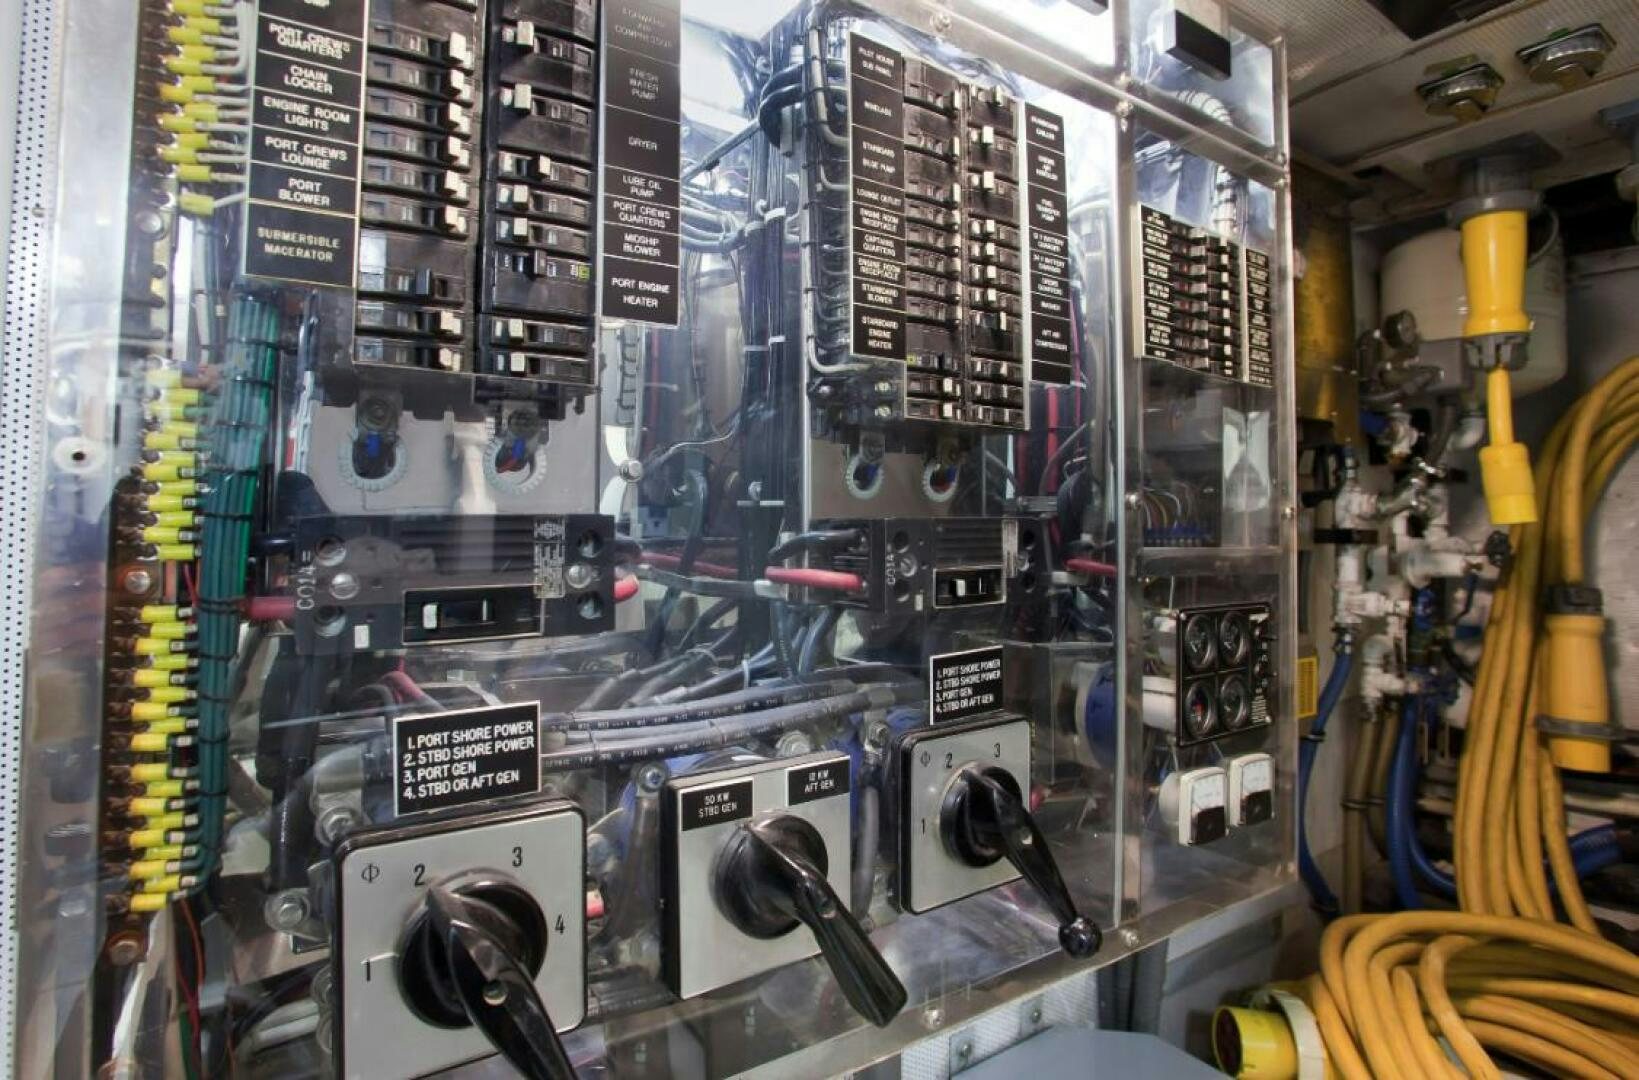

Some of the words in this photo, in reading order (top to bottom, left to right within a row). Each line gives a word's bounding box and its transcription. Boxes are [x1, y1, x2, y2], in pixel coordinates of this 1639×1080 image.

[269, 22, 303, 40] PORT
[277, 37, 342, 60] QUARTERS
[290, 64, 328, 82] CHAIN
[629, 67, 659, 82] FRESH
[284, 74, 332, 94] LOCKER
[629, 78, 659, 94] WATER
[631, 88, 656, 101] PUMP
[263, 96, 310, 115] ENGINE
[314, 107, 350, 123] ROOM
[285, 113, 329, 131] LIGHTS
[265, 136, 299, 151] PORT
[304, 143, 348, 161] CREWS
[628, 136, 657, 151] DRYER
[281, 152, 331, 170] LOUNGE
[288, 178, 322, 192] PORT
[623, 175, 646, 187] LUBE
[648, 180, 662, 191] OIL
[278, 189, 330, 206] BLOWER
[630, 186, 655, 198] PUMP
[613, 200, 637, 213] PORT
[639, 206, 671, 220] CREWS
[881, 213, 899, 224] ROOM
[618, 211, 666, 229] QUARTERS
[257, 227, 341, 248] SUBMERSIBLE
[624, 232, 660, 247] MIDSHIP
[264, 243, 333, 261] MACERATOR
[623, 242, 661, 257] BLOWER
[862, 242, 896, 257] QUARTERS
[611, 277, 636, 290] PORT
[638, 280, 670, 294] ENGINE
[623, 295, 659, 308] HEATER
[867, 292, 893, 305] BLOWER
[868, 328, 892, 339] ENGINE
[868, 339, 892, 350] HEATER
[942, 666, 959, 678] PORT
[960, 662, 980, 675] SHORE
[980, 659, 1000, 671] POWER
[960, 673, 980, 686] SHORE
[980, 669, 1000, 681] POWER
[942, 690, 959, 700] PORT
[959, 686, 973, 697] GEN
[981, 693, 994, 704] GEN
[417, 732, 451, 748] PORT
[452, 726, 492, 742] SHORE
[494, 721, 534, 738] POWER
[403, 753, 416, 767] 2.
[418, 748, 451, 765] STBD
[453, 742, 493, 760] SHORE
[495, 736, 535, 753] POWER
[994, 743, 1000, 758] 3
[945, 752, 953, 769] 2
[403, 770, 415, 784] 3.
[417, 765, 451, 781] PORT
[452, 761, 477, 776] GEN
[817, 769, 829, 780] KW
[403, 787, 416, 800] 4.
[418, 781, 451, 798] STBD
[453, 779, 469, 793] OR
[471, 774, 494, 789] AFT
[496, 770, 520, 785] GEN
[804, 782, 818, 793] AFT
[820, 779, 834, 790] GEN
[717, 792, 730, 803] KW
[698, 805, 720, 818] STBD
[721, 802, 737, 813] GEN
[921, 818, 925, 834] 1
[512, 846, 522, 867] 3
[414, 863, 426, 886] 2
[555, 914, 566, 934] 4
[365, 959, 371, 982] 1
